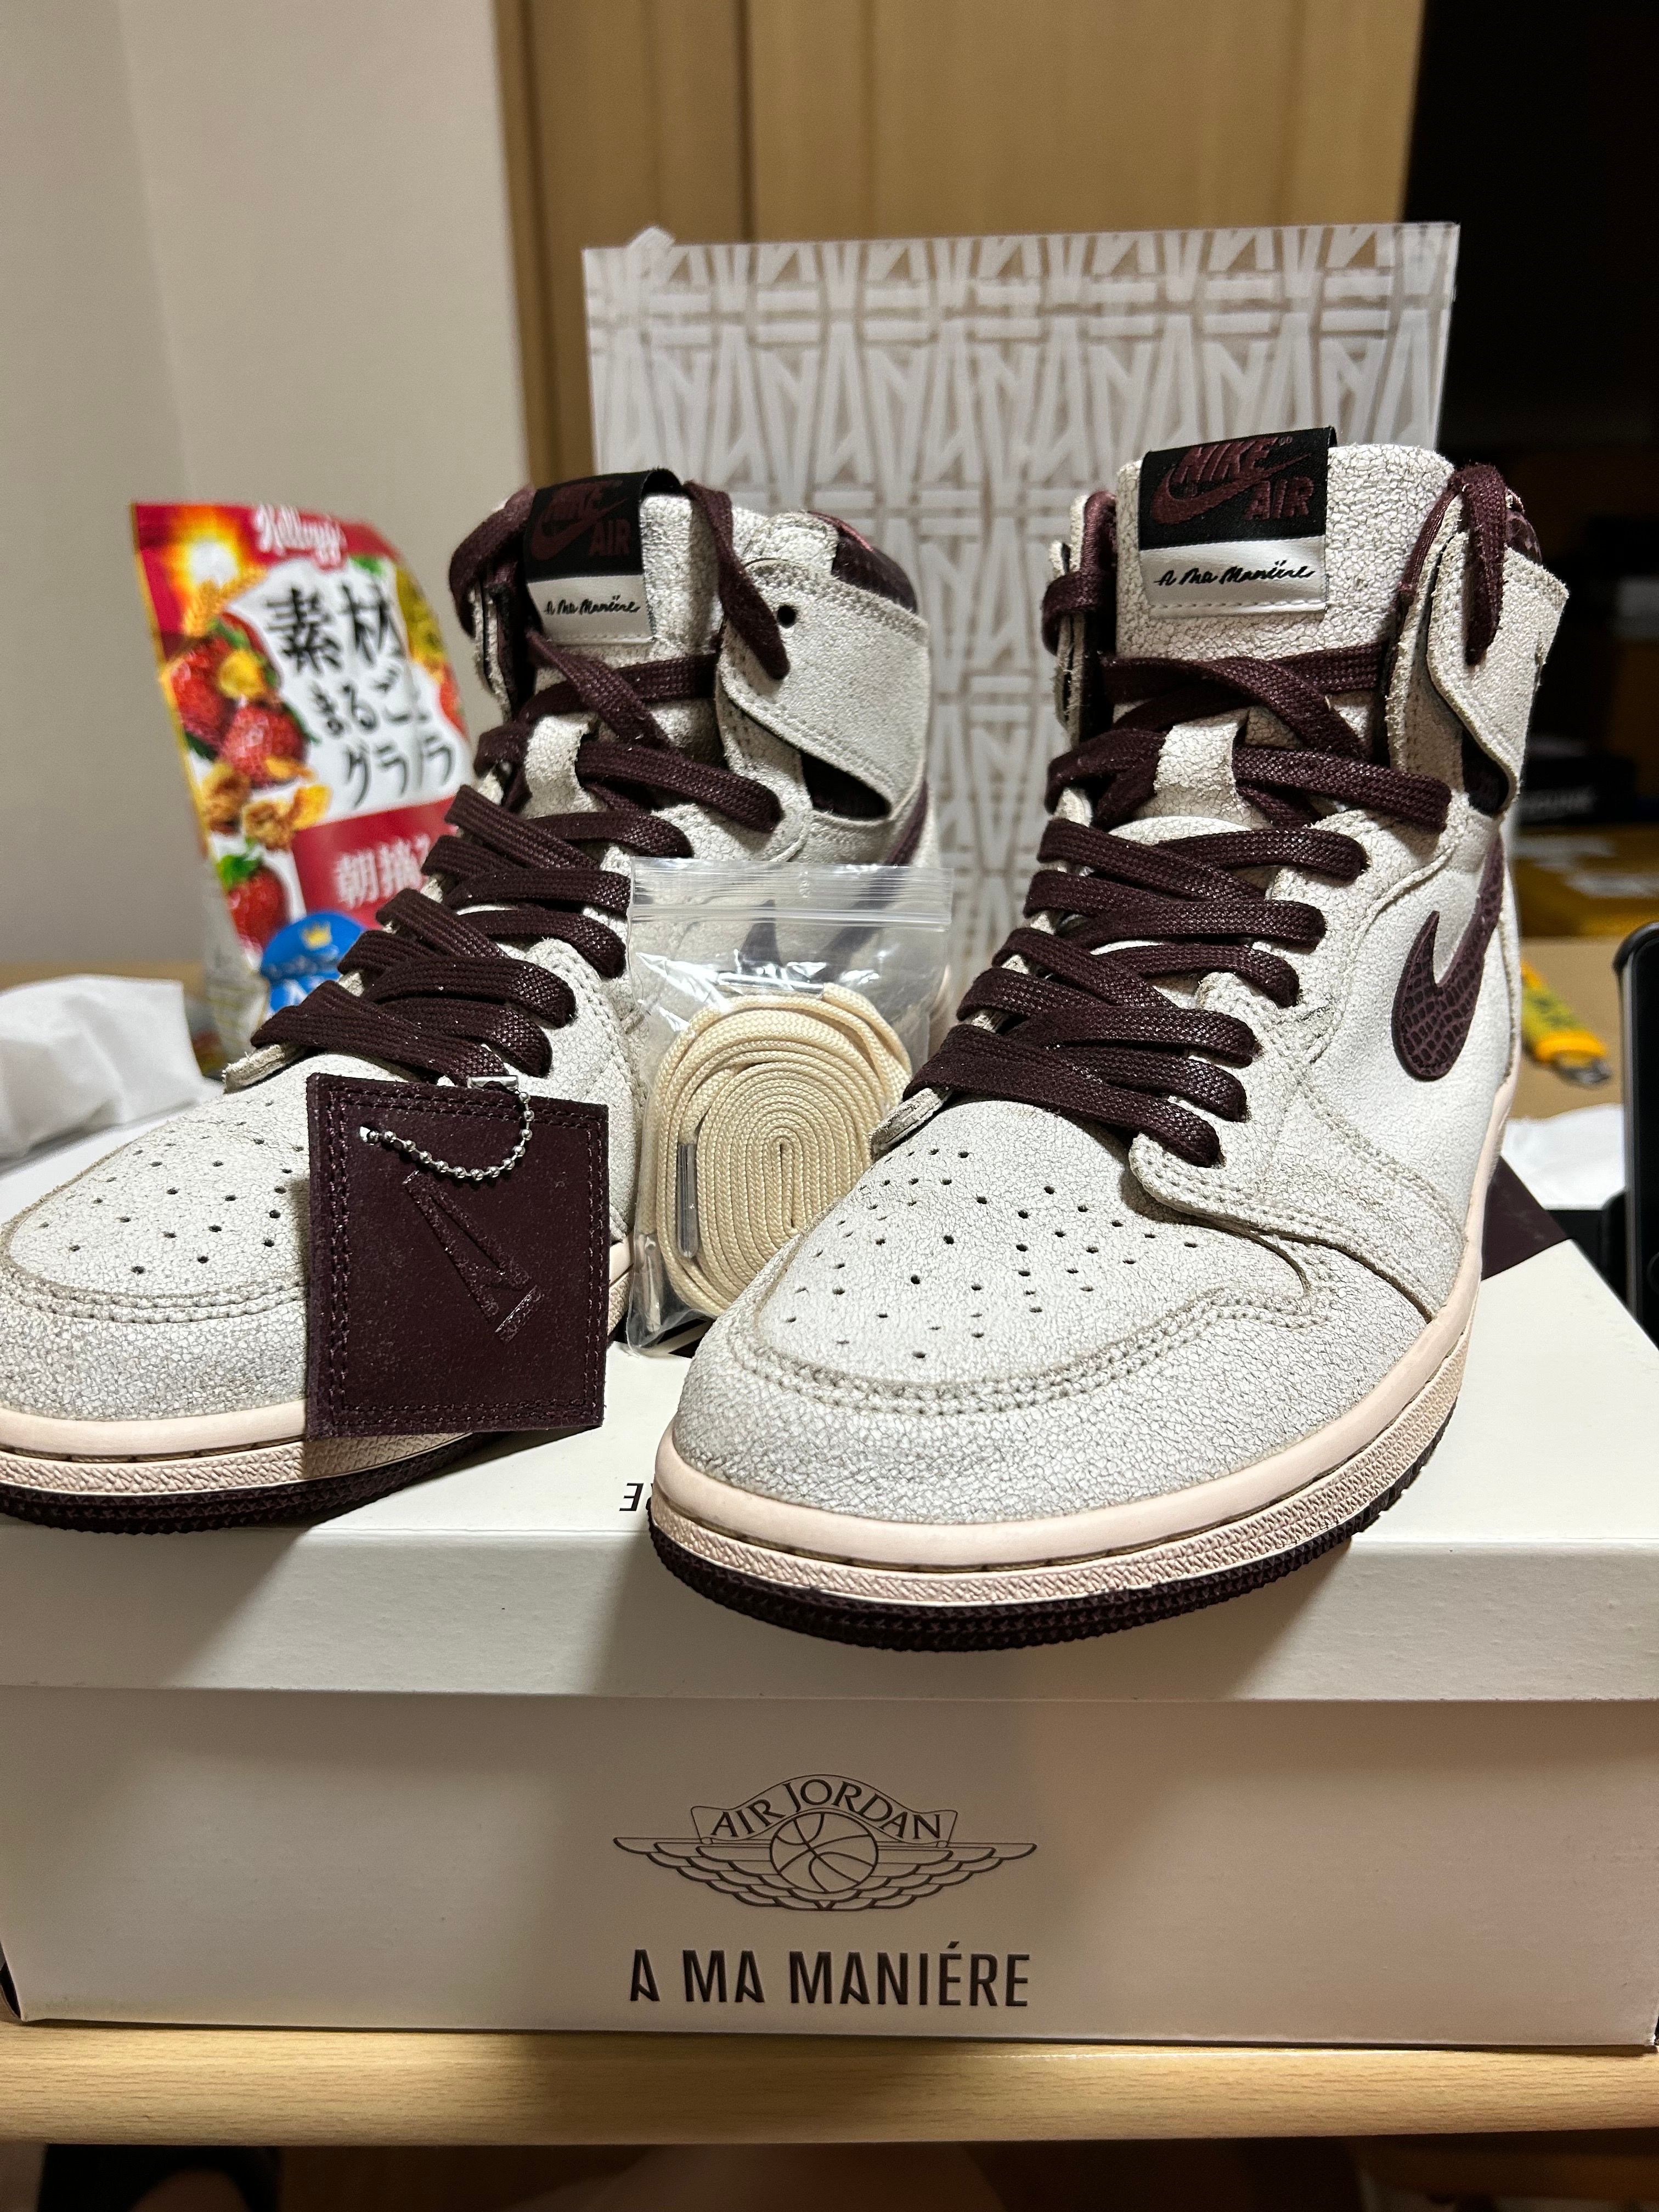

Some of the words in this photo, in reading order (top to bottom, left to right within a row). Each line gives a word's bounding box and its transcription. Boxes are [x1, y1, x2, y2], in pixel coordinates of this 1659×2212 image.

[1169, 437, 1279, 485] NIKE
[1243, 475, 1315, 521] AIR
[588, 517, 631, 557] AIR
[266, 583, 408, 675] 素材
[710, 1798, 786, 1838] AIR
[782, 1778, 941, 1839] JORDAN
[630, 1949, 661, 2002] A
[682, 1949, 765, 2004] MA
[788, 1940, 1030, 2007] MANIÉRE
